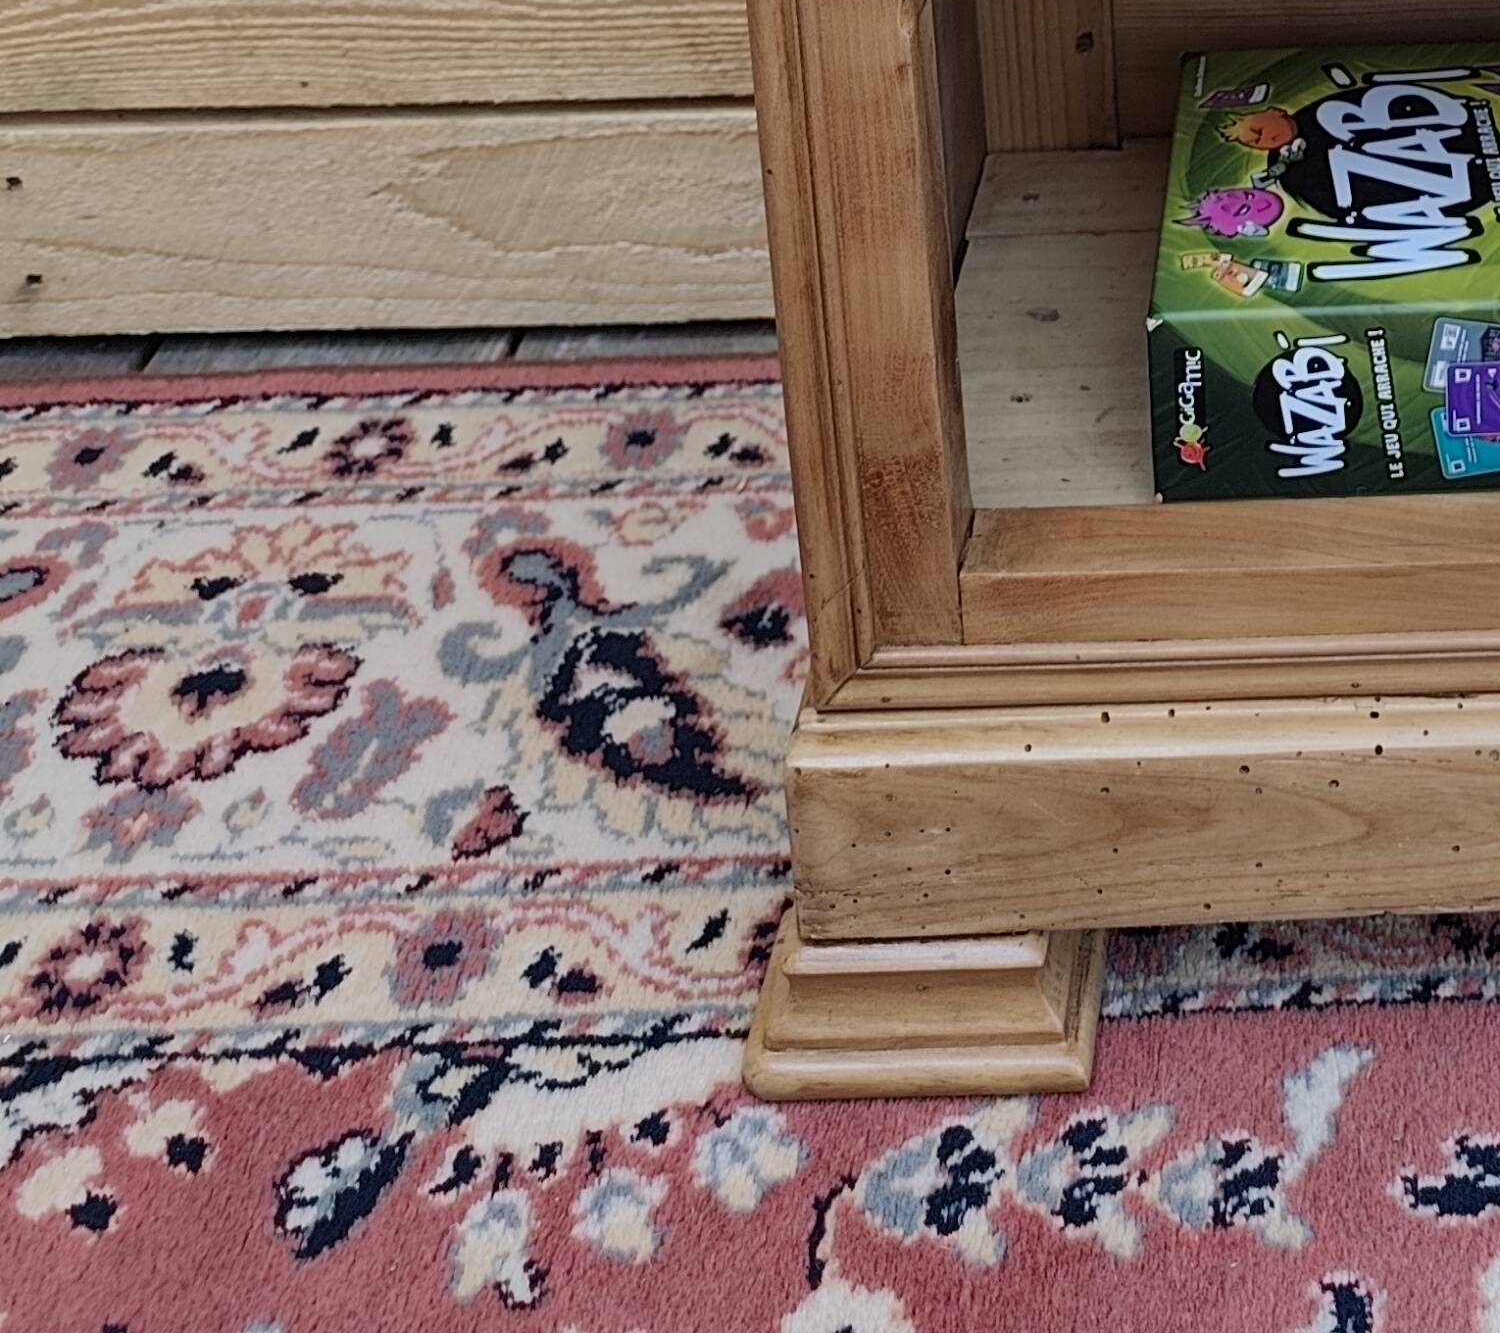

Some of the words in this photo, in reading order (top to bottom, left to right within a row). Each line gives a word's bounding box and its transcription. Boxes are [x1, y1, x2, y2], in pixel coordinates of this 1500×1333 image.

[1472, 107, 1500, 156] ARRACHE
[1370, 338, 1393, 401] ARRACHE
[1380, 403, 1398, 431] QUI
[1385, 434, 1402, 460] JEU
[1389, 462, 1405, 479] LE
